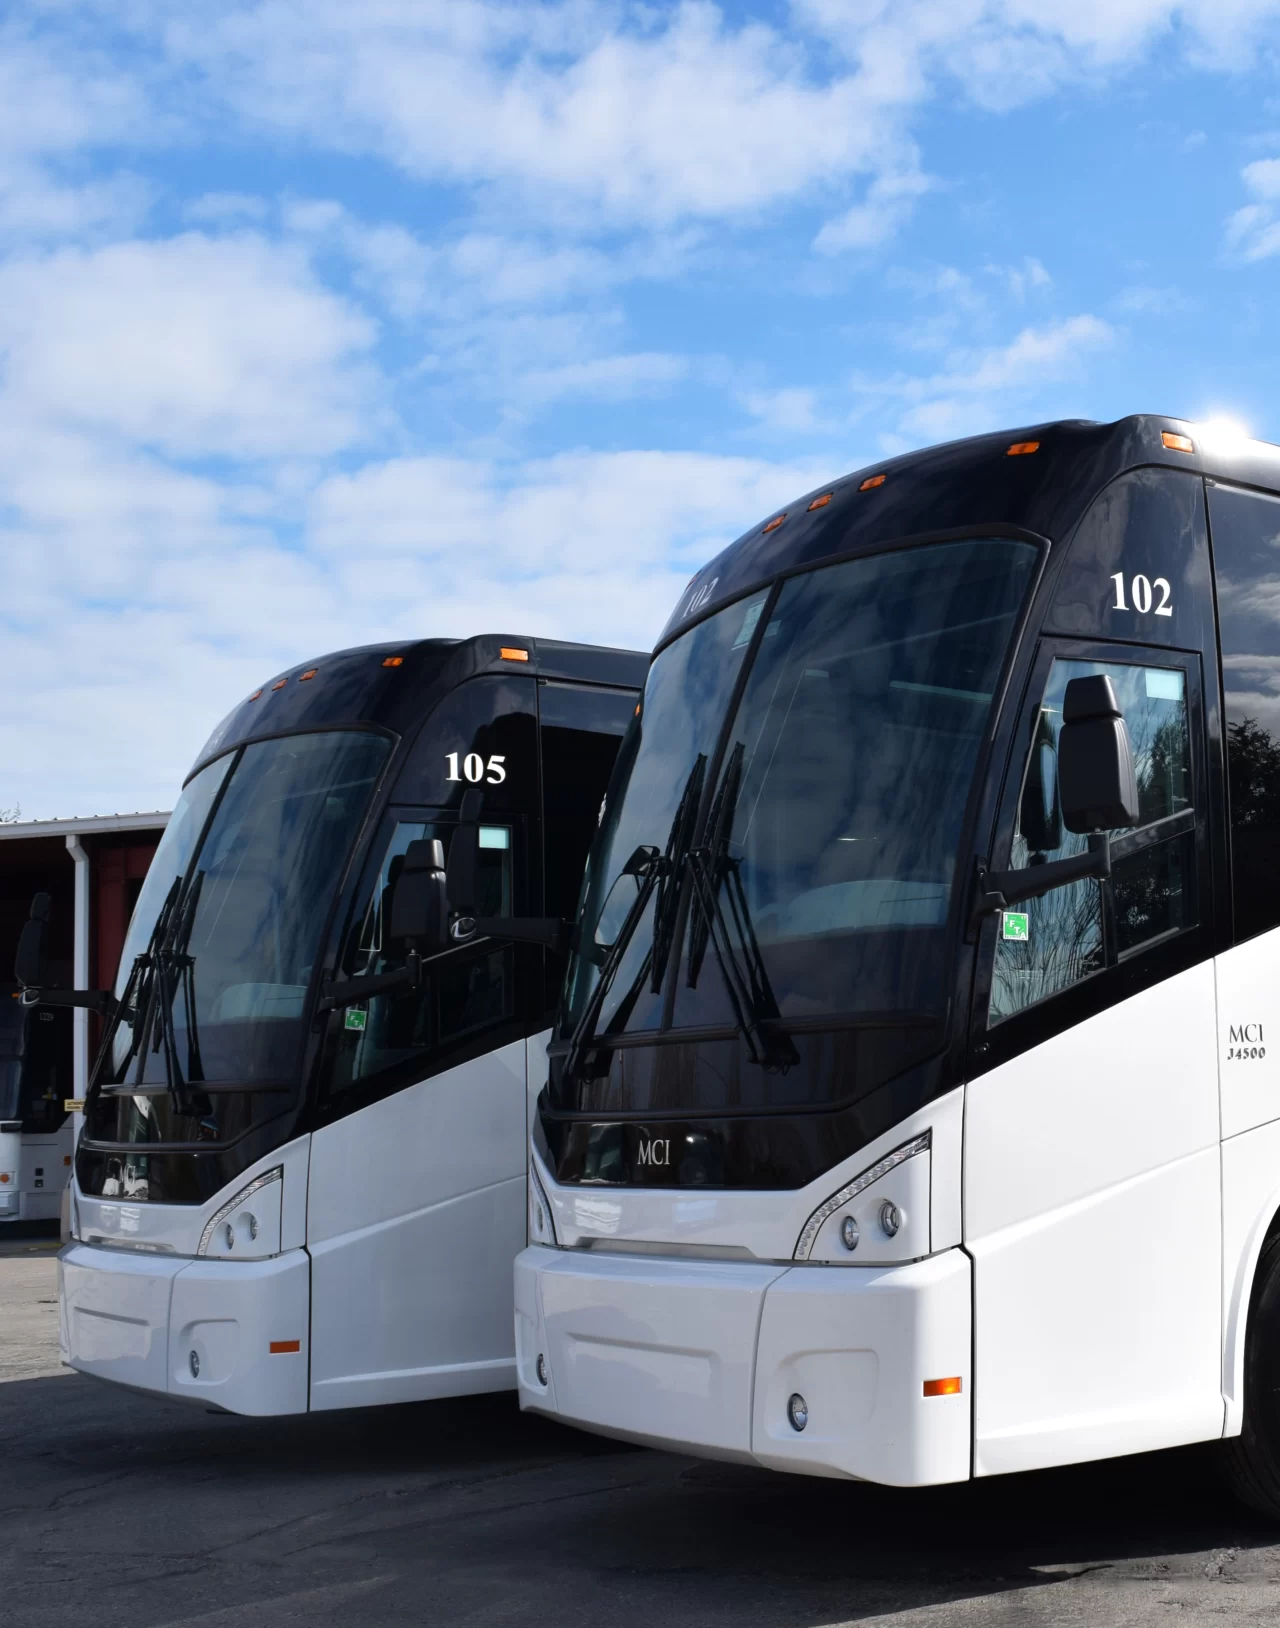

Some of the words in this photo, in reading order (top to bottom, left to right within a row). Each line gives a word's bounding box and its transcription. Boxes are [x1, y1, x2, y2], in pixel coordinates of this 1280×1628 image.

[681, 577, 719, 619] 102
[1110, 572, 1173, 617] 102
[445, 752, 506, 784] 105
[1228, 1023, 1264, 1043] MCI
[1227, 1047, 1266, 1060] J4500
[637, 1139, 671, 1165] MCI
